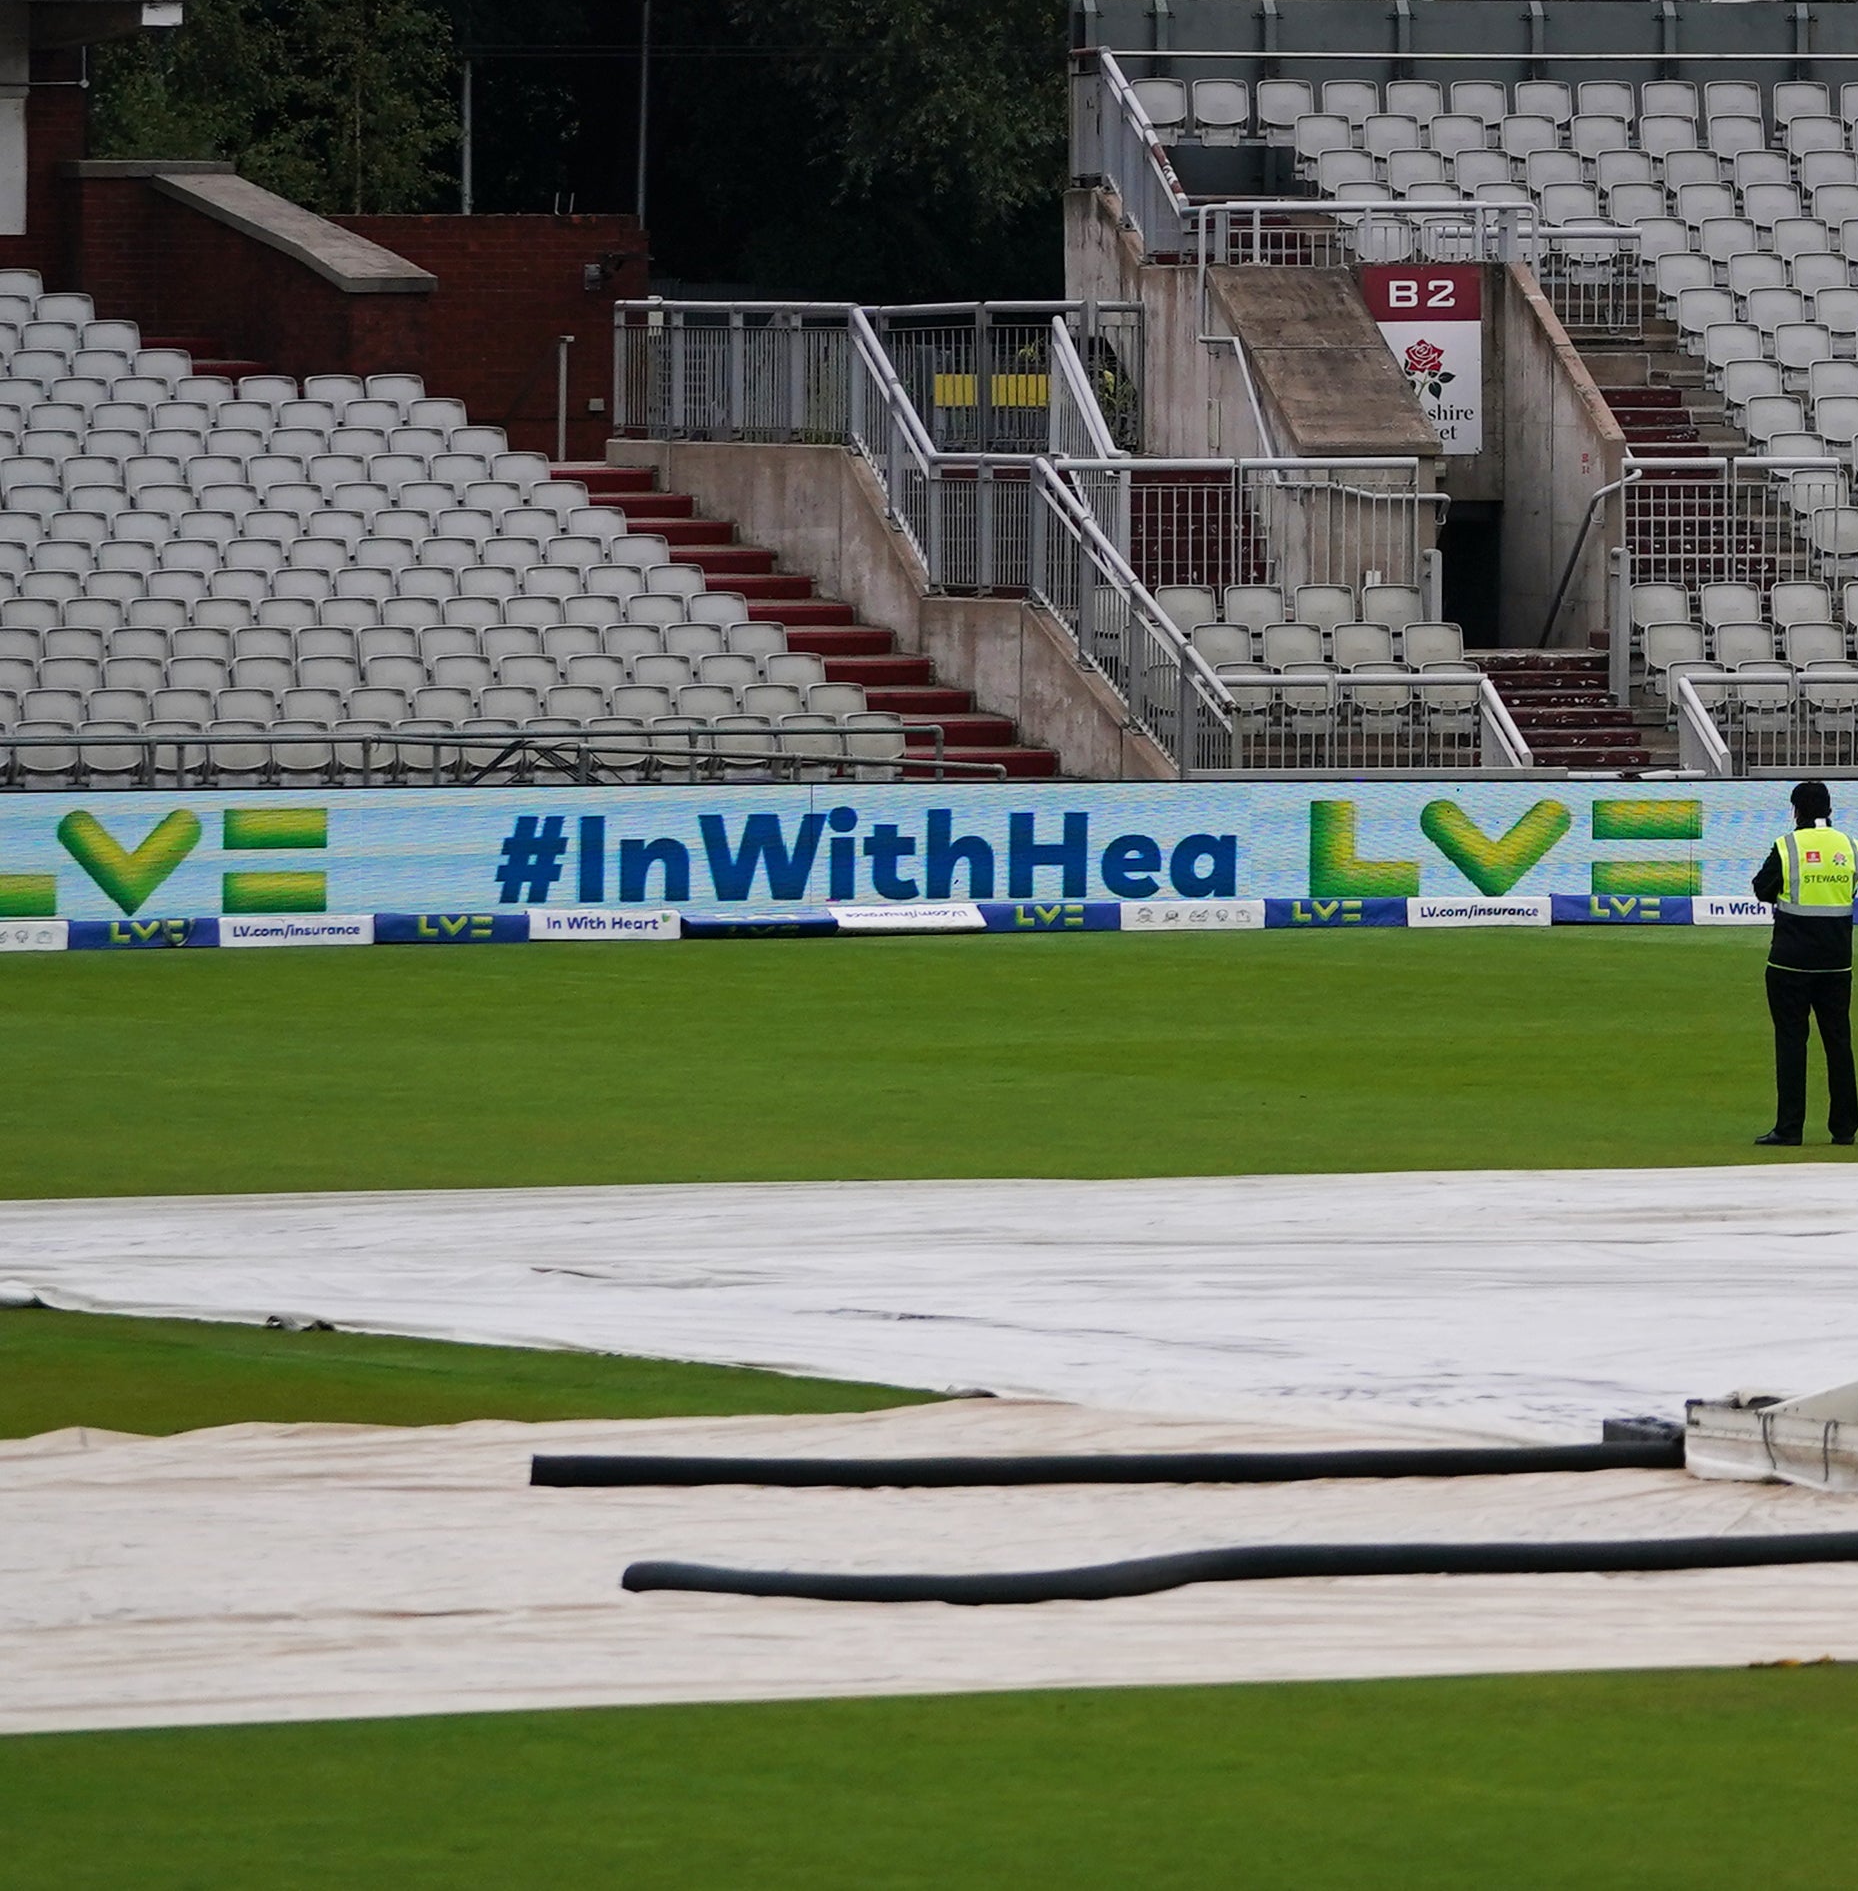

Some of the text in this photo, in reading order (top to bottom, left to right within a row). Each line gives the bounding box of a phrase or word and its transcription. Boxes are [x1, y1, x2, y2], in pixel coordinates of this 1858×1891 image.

[1388, 280, 1456, 309] B2
[1427, 404, 1474, 422] shire
[1803, 874, 1850, 885] STEWARD
[1420, 904, 1539, 920] LV.com/insurance
[1710, 903, 1724, 915] In
[1729, 902, 1766, 915] With
[546, 915, 659, 931] In With Heart
[232, 923, 361, 940] LV.com/insurance
